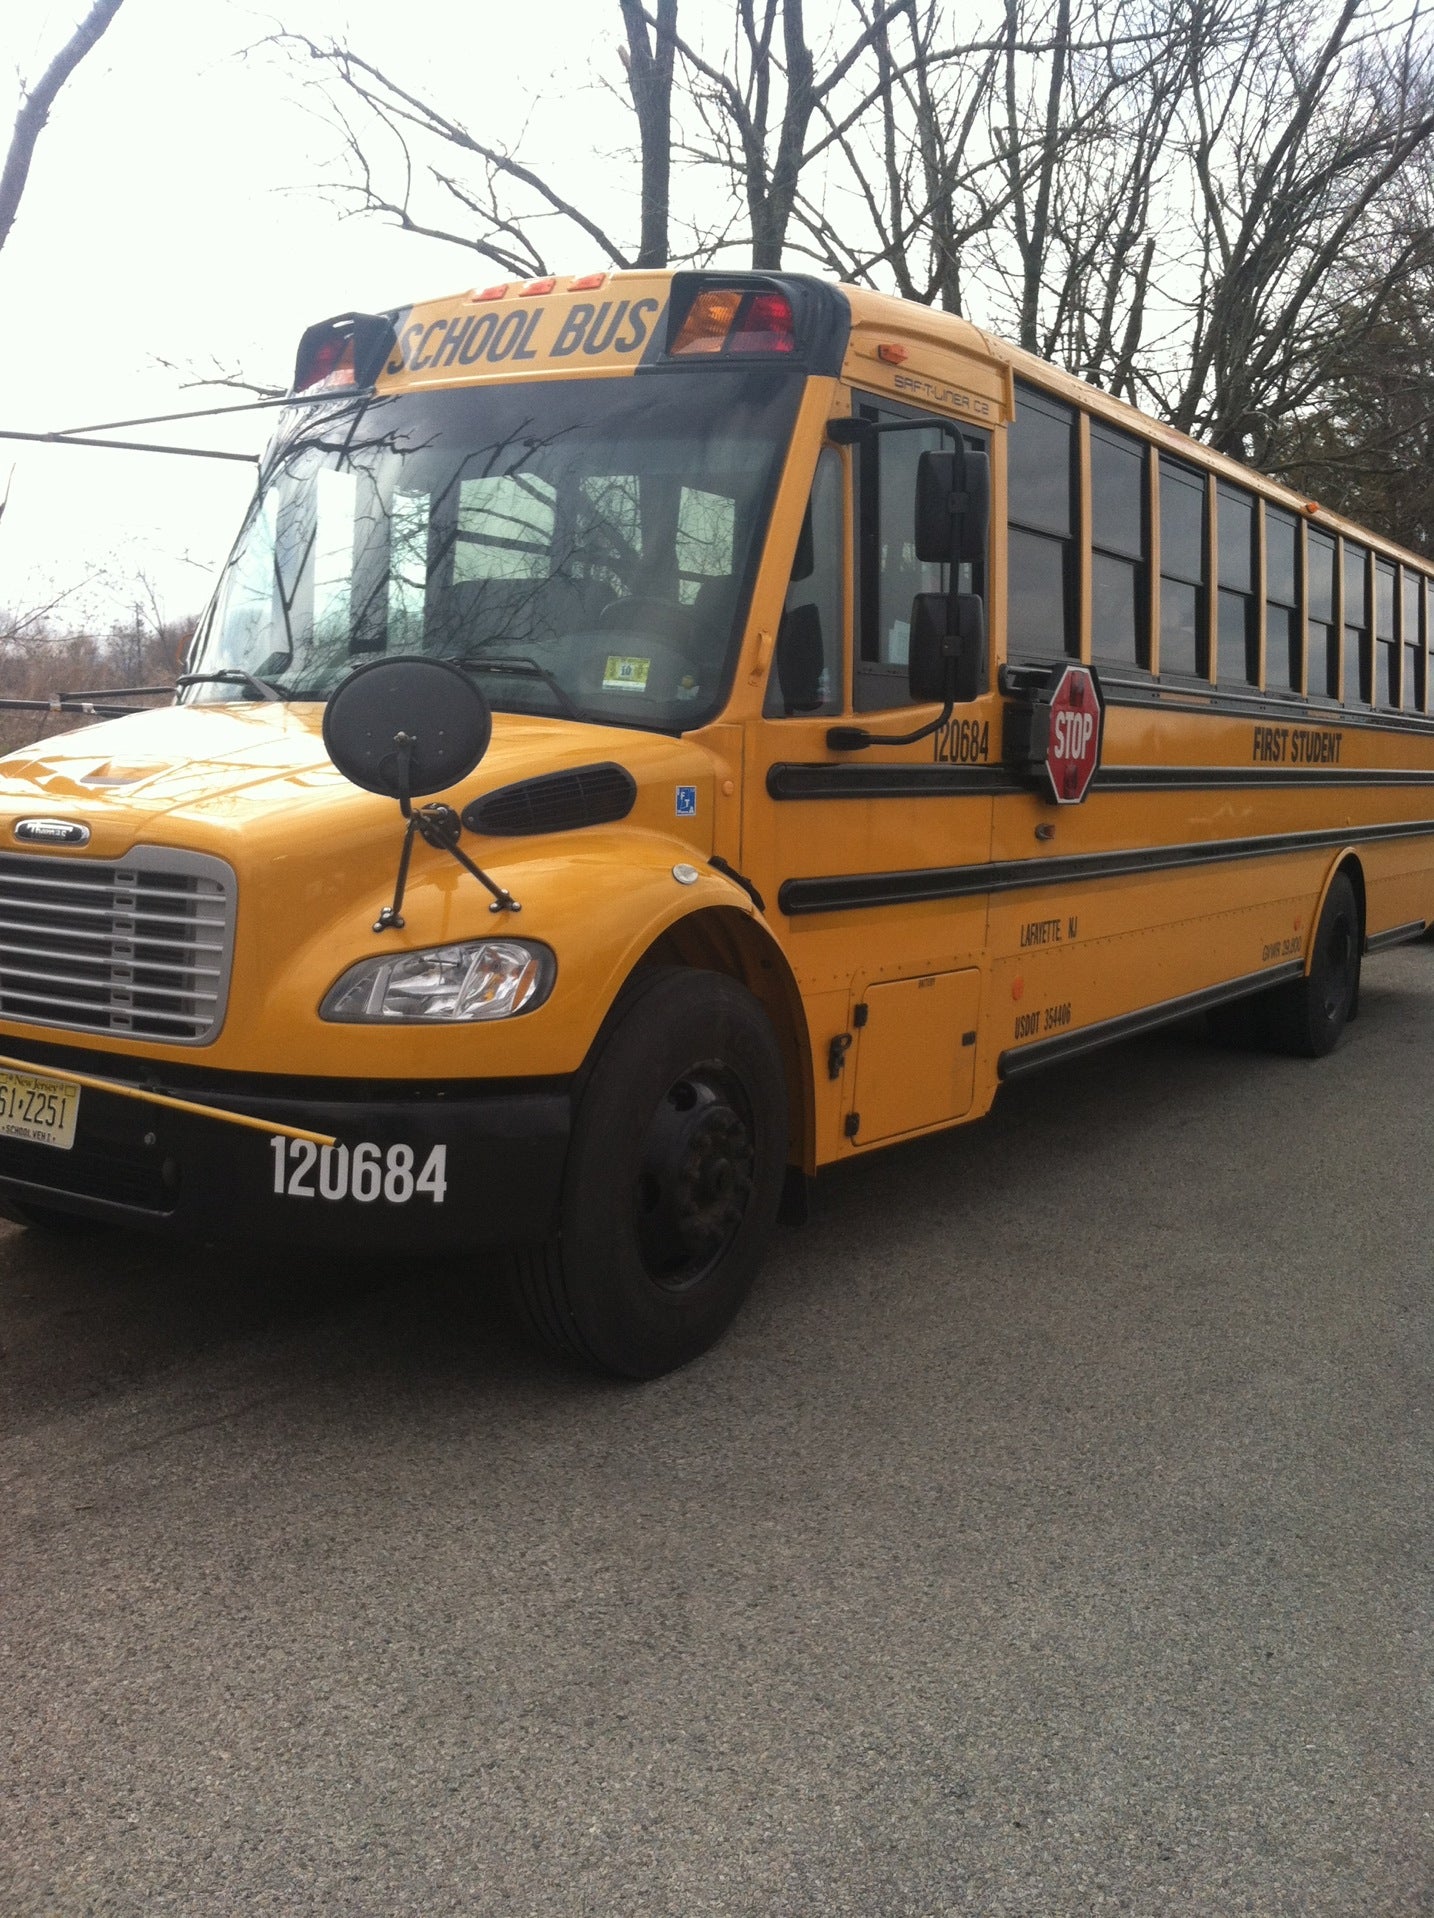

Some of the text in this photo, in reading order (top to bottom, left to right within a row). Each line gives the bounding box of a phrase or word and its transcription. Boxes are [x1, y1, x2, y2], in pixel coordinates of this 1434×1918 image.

[386, 298, 659, 375] SCHOOL BUS
[934, 719, 989, 762] 120684
[1054, 711, 1093, 759] STOP
[1253, 726, 1342, 763] FIRST STUDENT
[1068, 916, 1078, 939] NJ
[1014, 1002, 1072, 1040] USDOT 354406
[6, 1124, 30, 1137] SCHOOL
[270, 1135, 447, 1203] 120684
